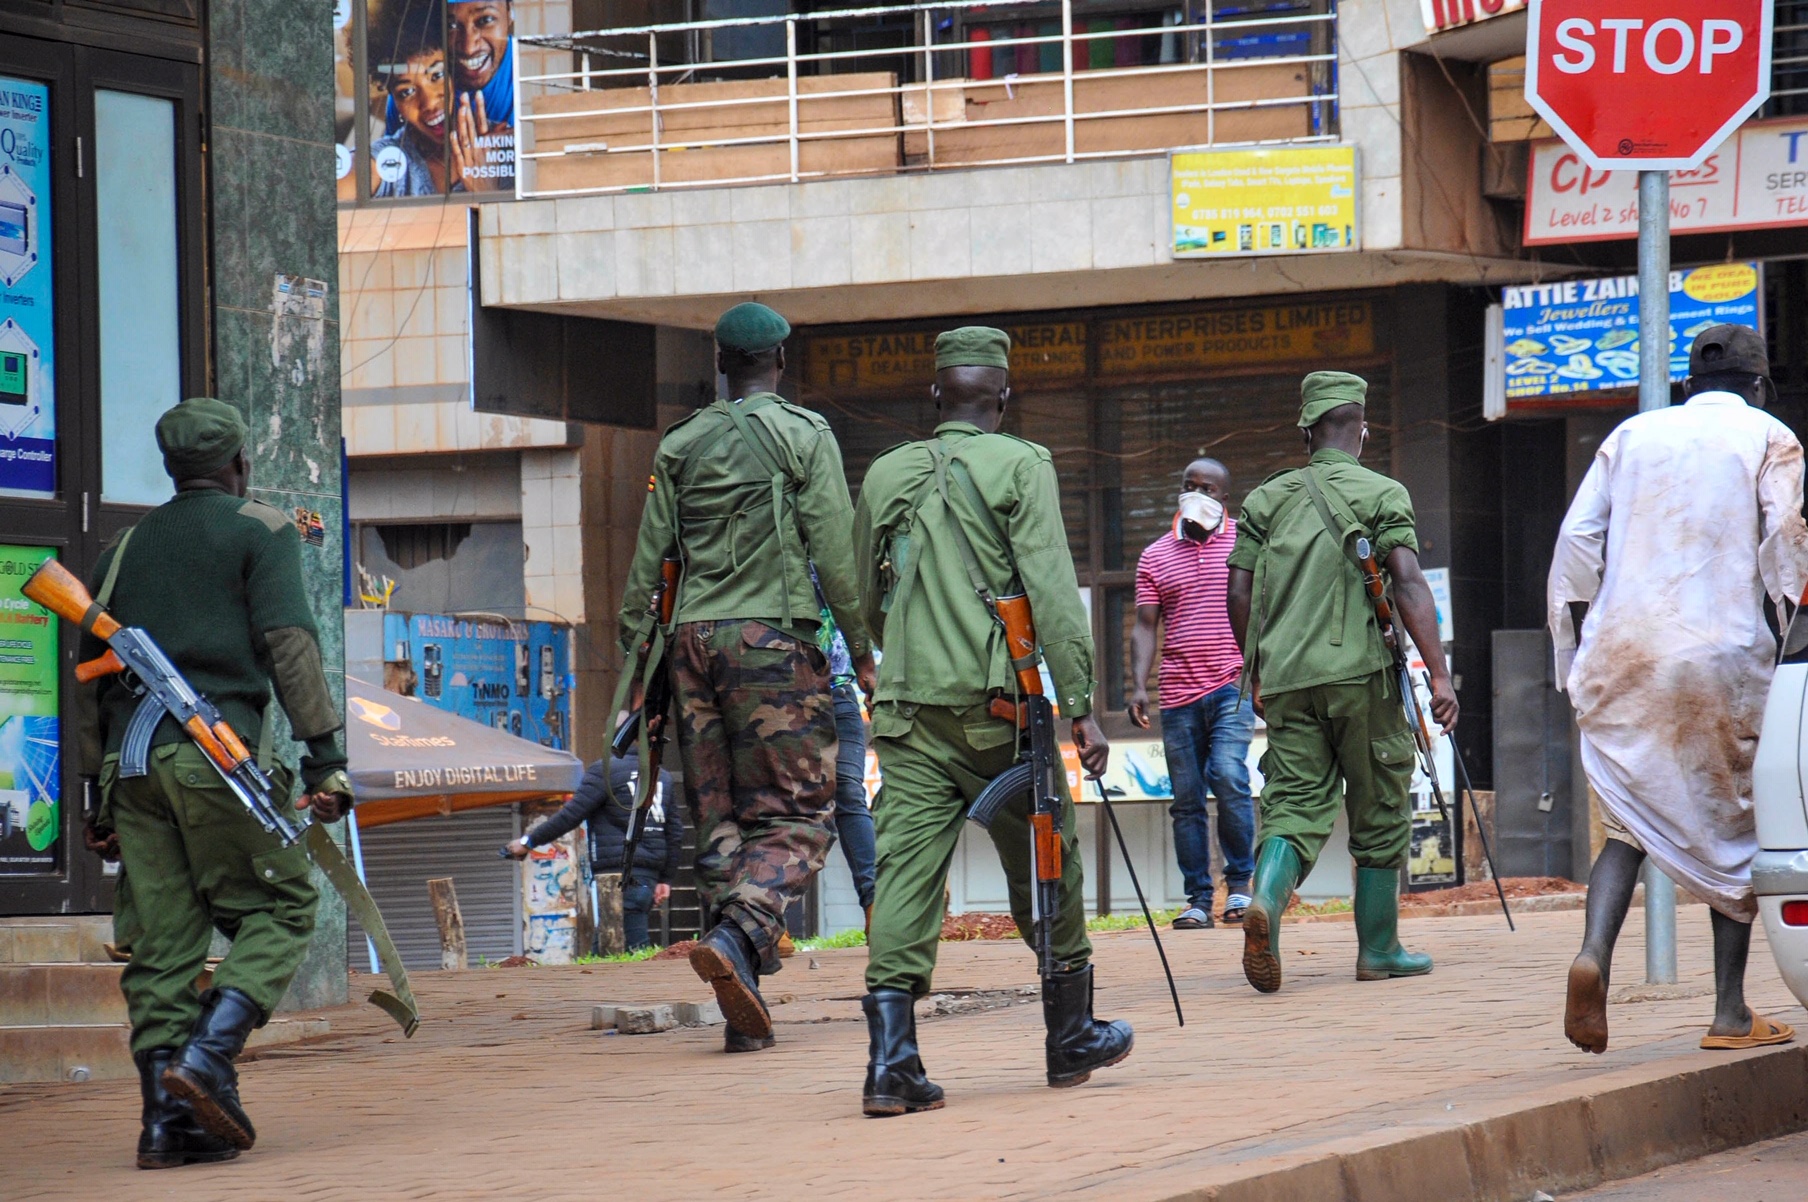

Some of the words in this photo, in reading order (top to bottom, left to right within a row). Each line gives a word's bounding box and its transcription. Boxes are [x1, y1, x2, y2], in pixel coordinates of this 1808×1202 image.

[1552, 18, 1743, 74] STOP
[1, 128, 43, 164] Quality
[474, 135, 514, 148] MAKIN
[486, 150, 515, 163] MOR
[463, 165, 515, 178] POSSIBL
[1766, 171, 1808, 190] SER
[1550, 203, 1597, 228] Level
[1602, 207, 1614, 222] 2
[1697, 198, 1708, 218] 7
[1503, 281, 1579, 310] ATTIE
[1503, 327, 1524, 337] We
[1526, 324, 1552, 335] Sell
[1554, 318, 1613, 331] Wedding
[1614, 316, 1626, 326] &
[1714, 305, 1754, 316] Rings
[1537, 301, 1630, 324] Jewellers
[849, 334, 935, 357] STANLE
[1101, 311, 1265, 345] ENTERPRISES
[1275, 304, 1366, 331] LIMITED
[1203, 334, 1292, 353] PRODUCTS
[1508, 375, 1547, 387] LEVEL
[1550, 374, 1561, 384] 2
[1506, 386, 1545, 397] SHOP
[369, 733, 456, 747] StarTimes
[394, 769, 442, 788] ENJOY
[445, 766, 503, 786] DIGITAL
[503, 764, 537, 782] LIFE
